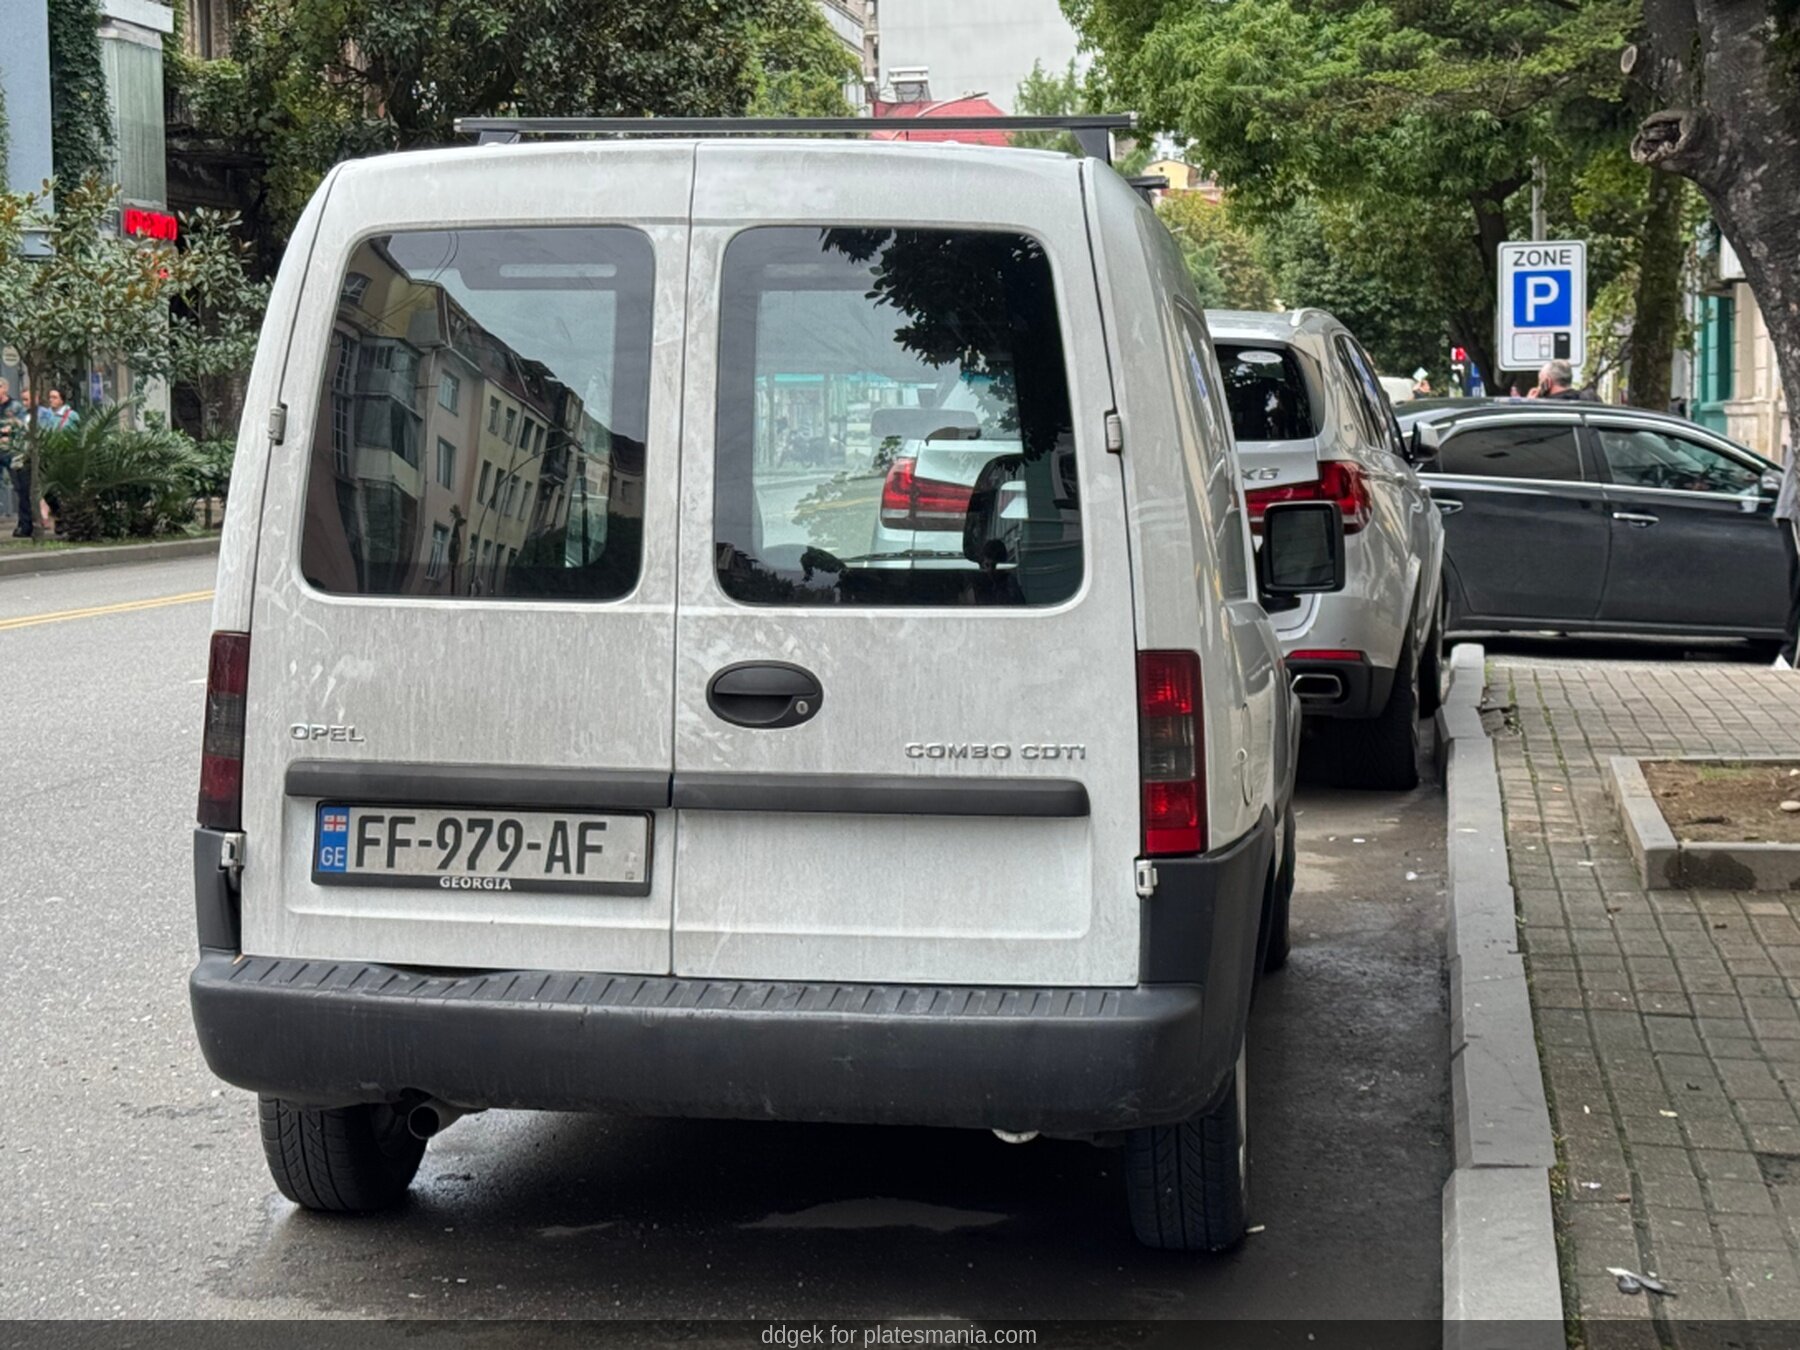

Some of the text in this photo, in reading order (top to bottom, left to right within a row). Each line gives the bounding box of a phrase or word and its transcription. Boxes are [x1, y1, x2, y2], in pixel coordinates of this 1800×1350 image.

[1513, 249, 1572, 267] ZONE
[1525, 276, 1560, 322] P
[289, 723, 365, 742] OPEL
[904, 742, 1086, 761] COMBO CDTI
[355, 814, 607, 875] FF-979-AF
[321, 846, 346, 868] GE
[439, 875, 512, 891] GEORGIA
